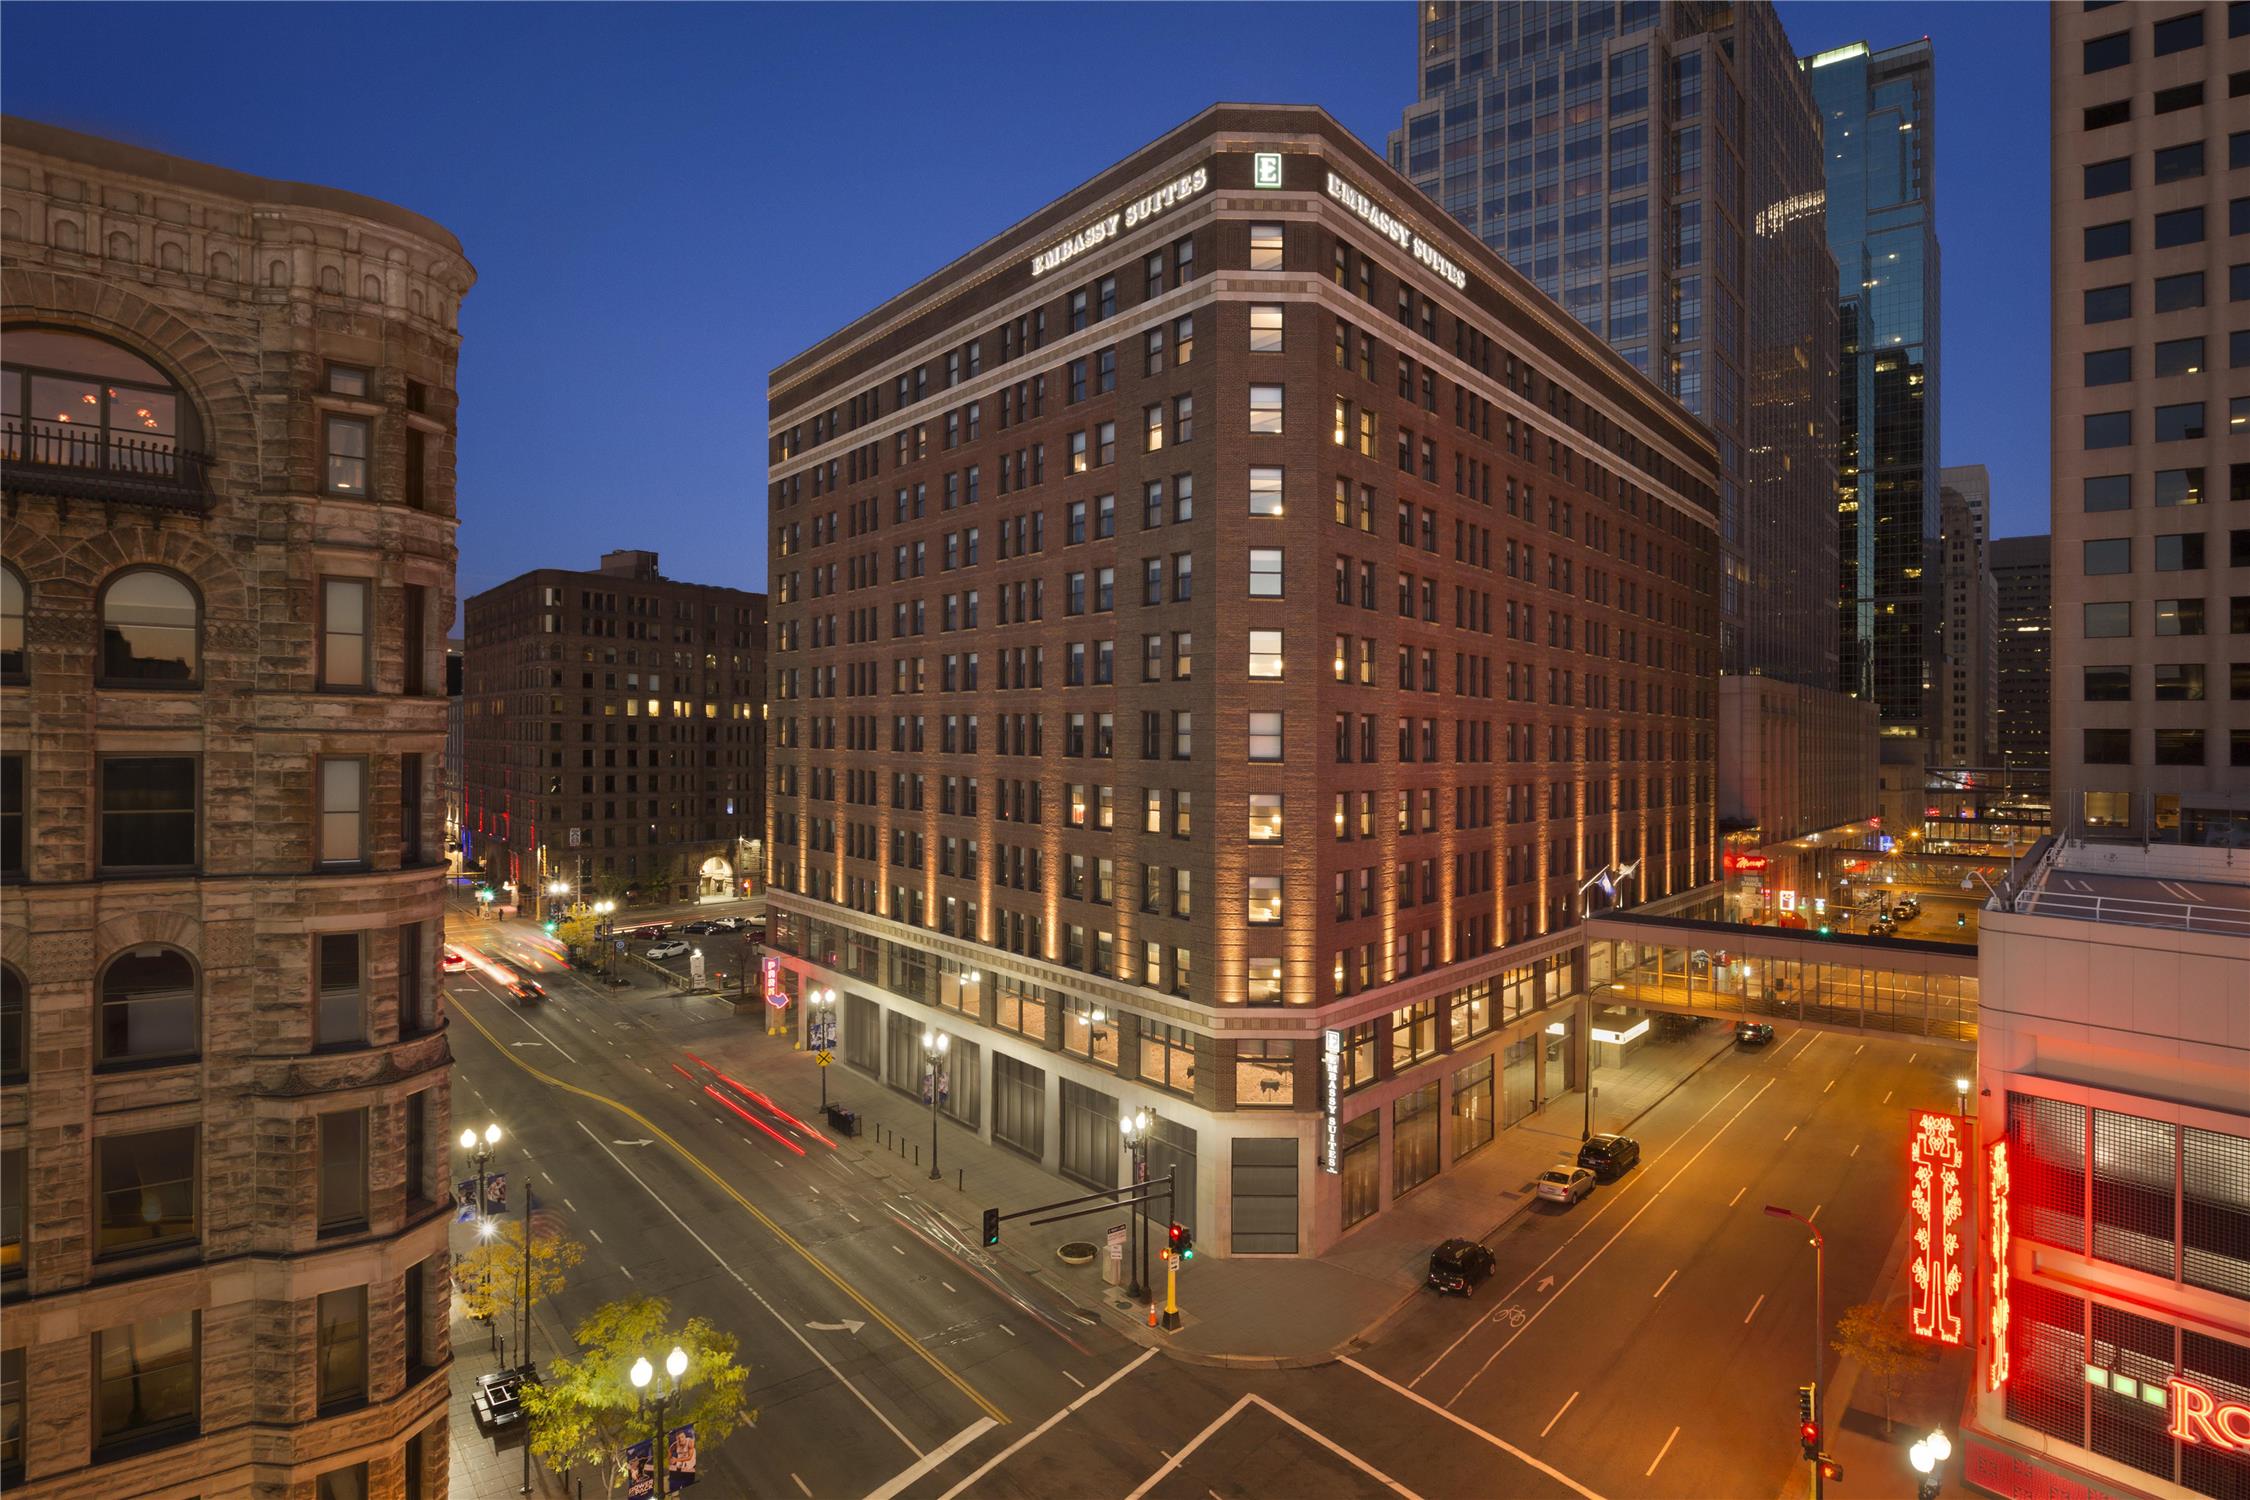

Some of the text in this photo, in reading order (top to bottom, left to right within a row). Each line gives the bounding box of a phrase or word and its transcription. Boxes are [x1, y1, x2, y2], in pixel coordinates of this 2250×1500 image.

[1031, 167, 1207, 276] EMBASSY SUITES
[1327, 172, 1467, 290] EMBASSY SUITES
[767, 961, 776, 996] PARK
[1327, 1055, 1338, 1167] EMBASSY SUITES
